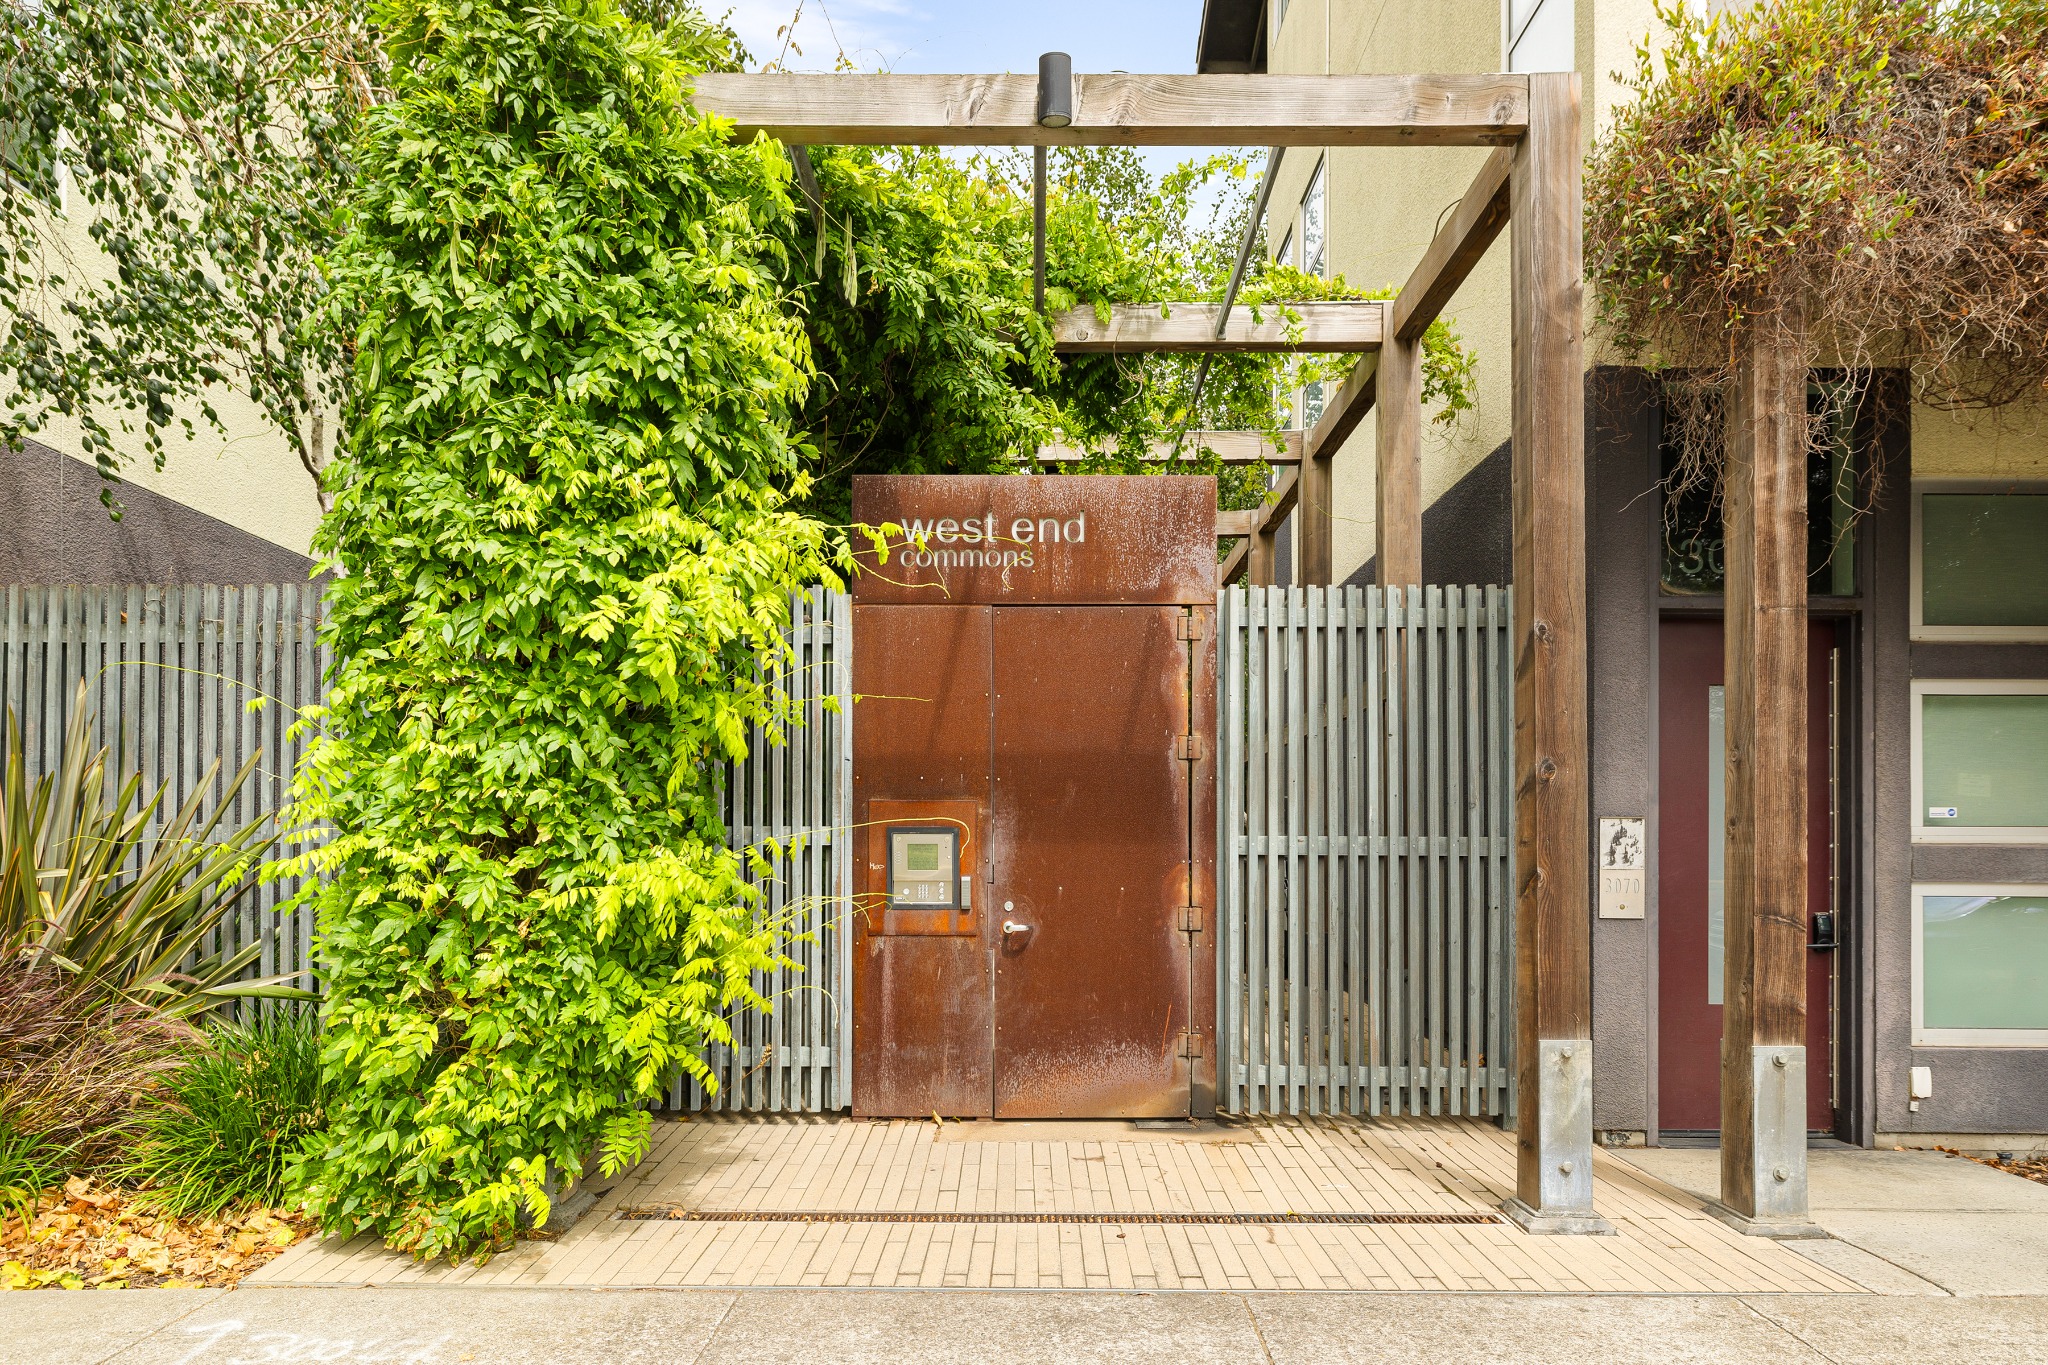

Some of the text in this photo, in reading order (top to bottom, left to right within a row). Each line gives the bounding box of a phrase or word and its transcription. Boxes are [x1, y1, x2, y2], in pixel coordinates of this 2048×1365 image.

[900, 509, 1086, 543] west end
[900, 549, 1035, 568] commons
[1605, 877, 1640, 894] 3070
